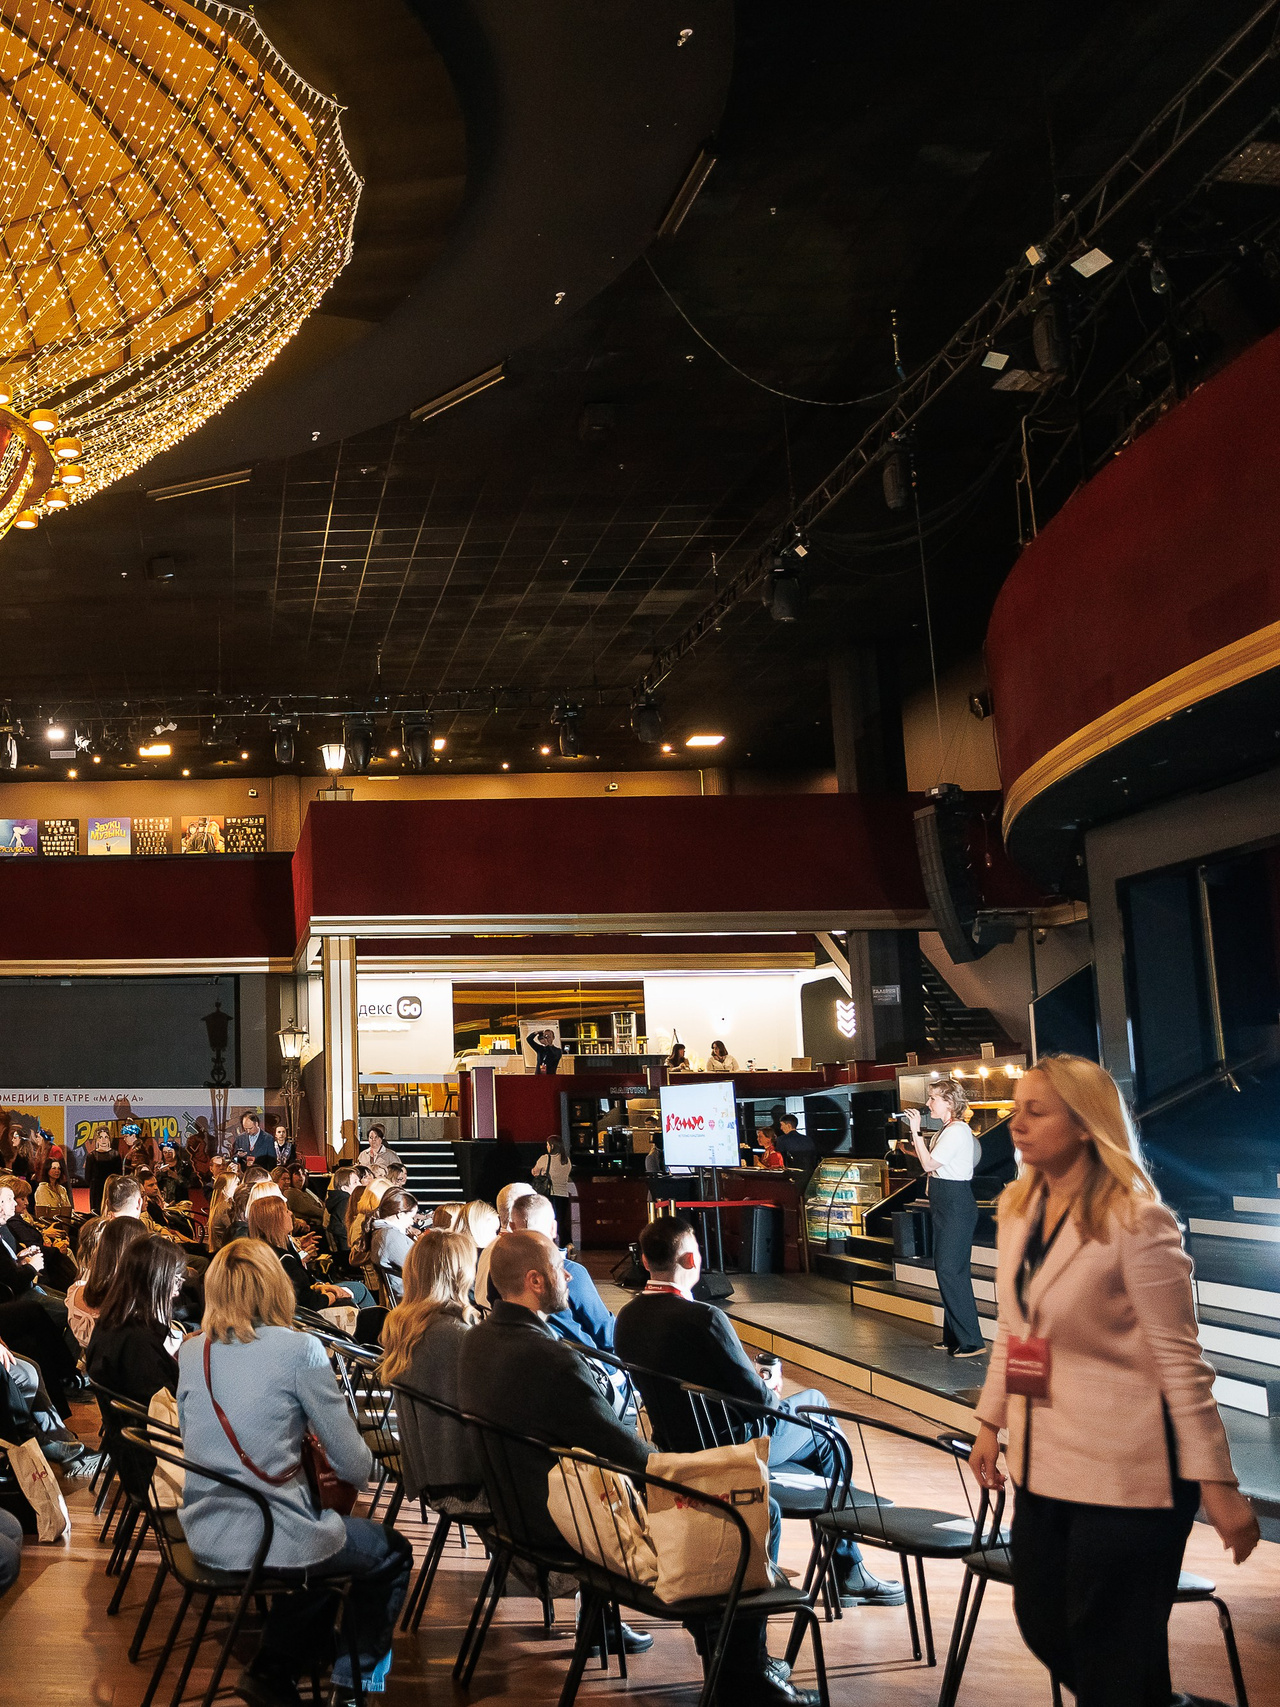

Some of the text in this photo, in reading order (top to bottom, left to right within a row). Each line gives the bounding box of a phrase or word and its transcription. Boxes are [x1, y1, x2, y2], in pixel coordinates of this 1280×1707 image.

[358, 999, 420, 1017] декс Go
[610, 1086, 648, 1095] MARTINI
[43, 1094, 50, 1102] В
[53, 1094, 90, 1102] ТЕАТРЕ
[93, 1094, 144, 1102] «МАСКА»
